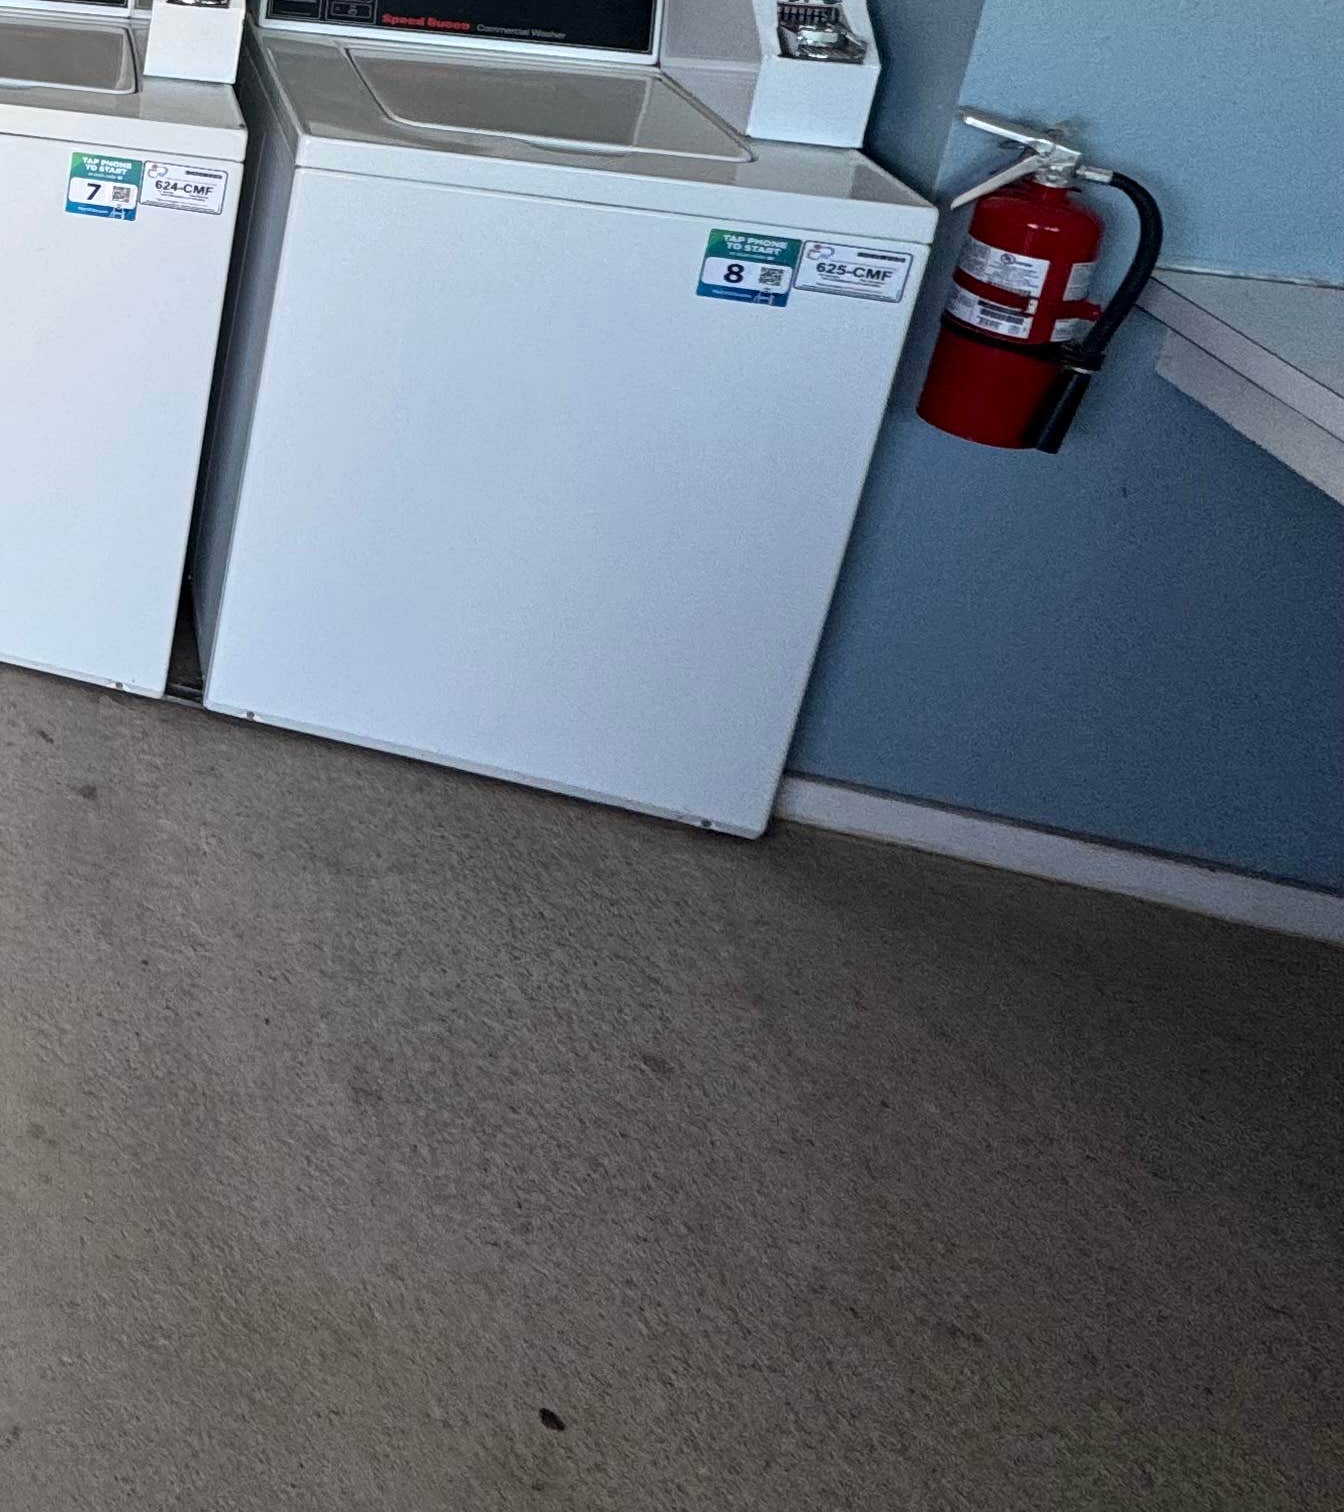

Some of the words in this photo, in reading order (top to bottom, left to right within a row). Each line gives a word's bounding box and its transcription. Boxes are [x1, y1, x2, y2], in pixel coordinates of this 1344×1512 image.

[382, 14, 425, 27] Speed
[428, 17, 470, 31] Queen
[99, 166, 128, 175] START
[101, 159, 132, 169] PHONE
[87, 182, 102, 201] 7
[155, 180, 214, 196] 624-CMF
[723, 235, 745, 243] TAP
[747, 237, 788, 249] PHONE
[726, 242, 742, 250] TO
[743, 245, 782, 255] START
[723, 264, 745, 284] 8
[816, 262, 892, 282] 625-CMF
